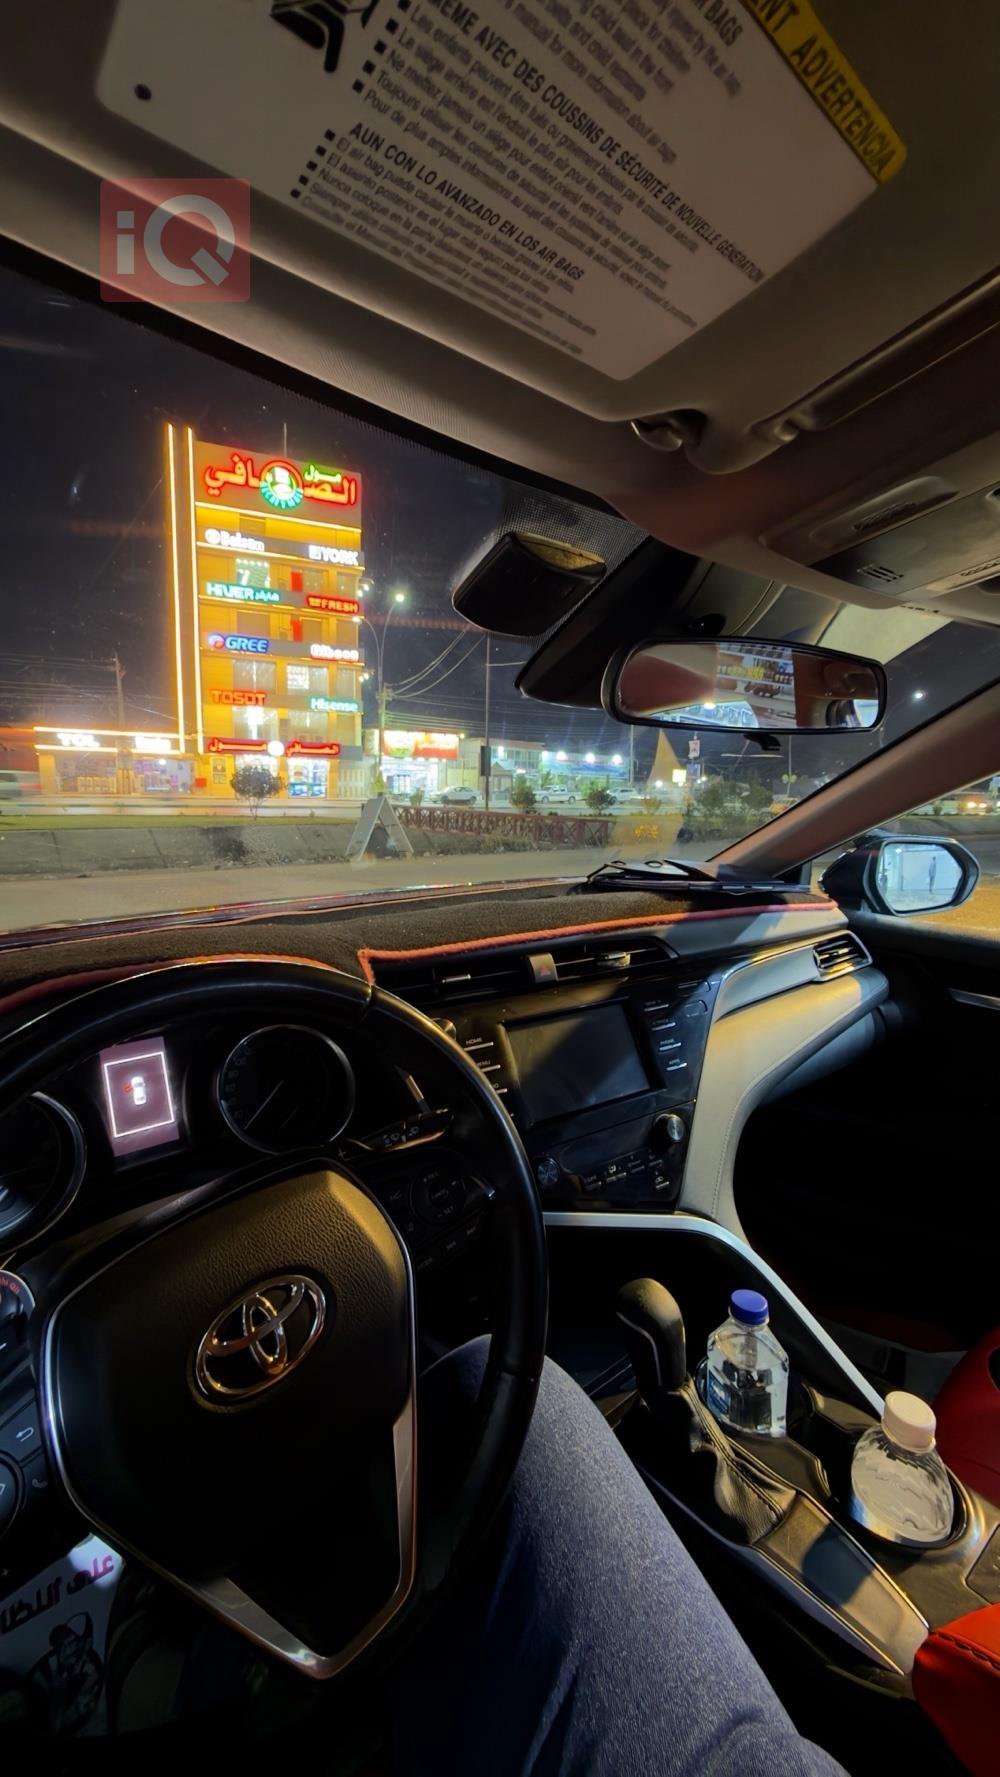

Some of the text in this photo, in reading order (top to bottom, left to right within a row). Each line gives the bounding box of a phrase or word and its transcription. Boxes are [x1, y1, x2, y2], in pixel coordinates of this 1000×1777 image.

[790, 32, 897, 176] ADVERTENCIA
[474, 28, 517, 69] AVEC
[512, 61, 546, 93] DES
[541, 85, 605, 144] COUSSINS
[598, 136, 621, 159] DE
[615, 150, 670, 199] SÉCURITÉ
[661, 191, 681, 211] DE
[674, 203, 722, 246] NOUVELLE
[349, 122, 385, 152] AUN
[384, 144, 418, 173] CON
[415, 164, 437, 185] LO
[434, 179, 501, 226] AVANZADO
[498, 220, 519, 238] EN
[514, 231, 540, 252] LOS
[535, 246, 558, 264] AIR
[554, 257, 585, 280] BAGS
[321, 546, 359, 566] YORK
[321, 598, 358, 614] FRESH
[226, 636, 268, 653] GREE
[211, 690, 266, 706] TOSOT
[311, 698, 358, 713] Hisense
